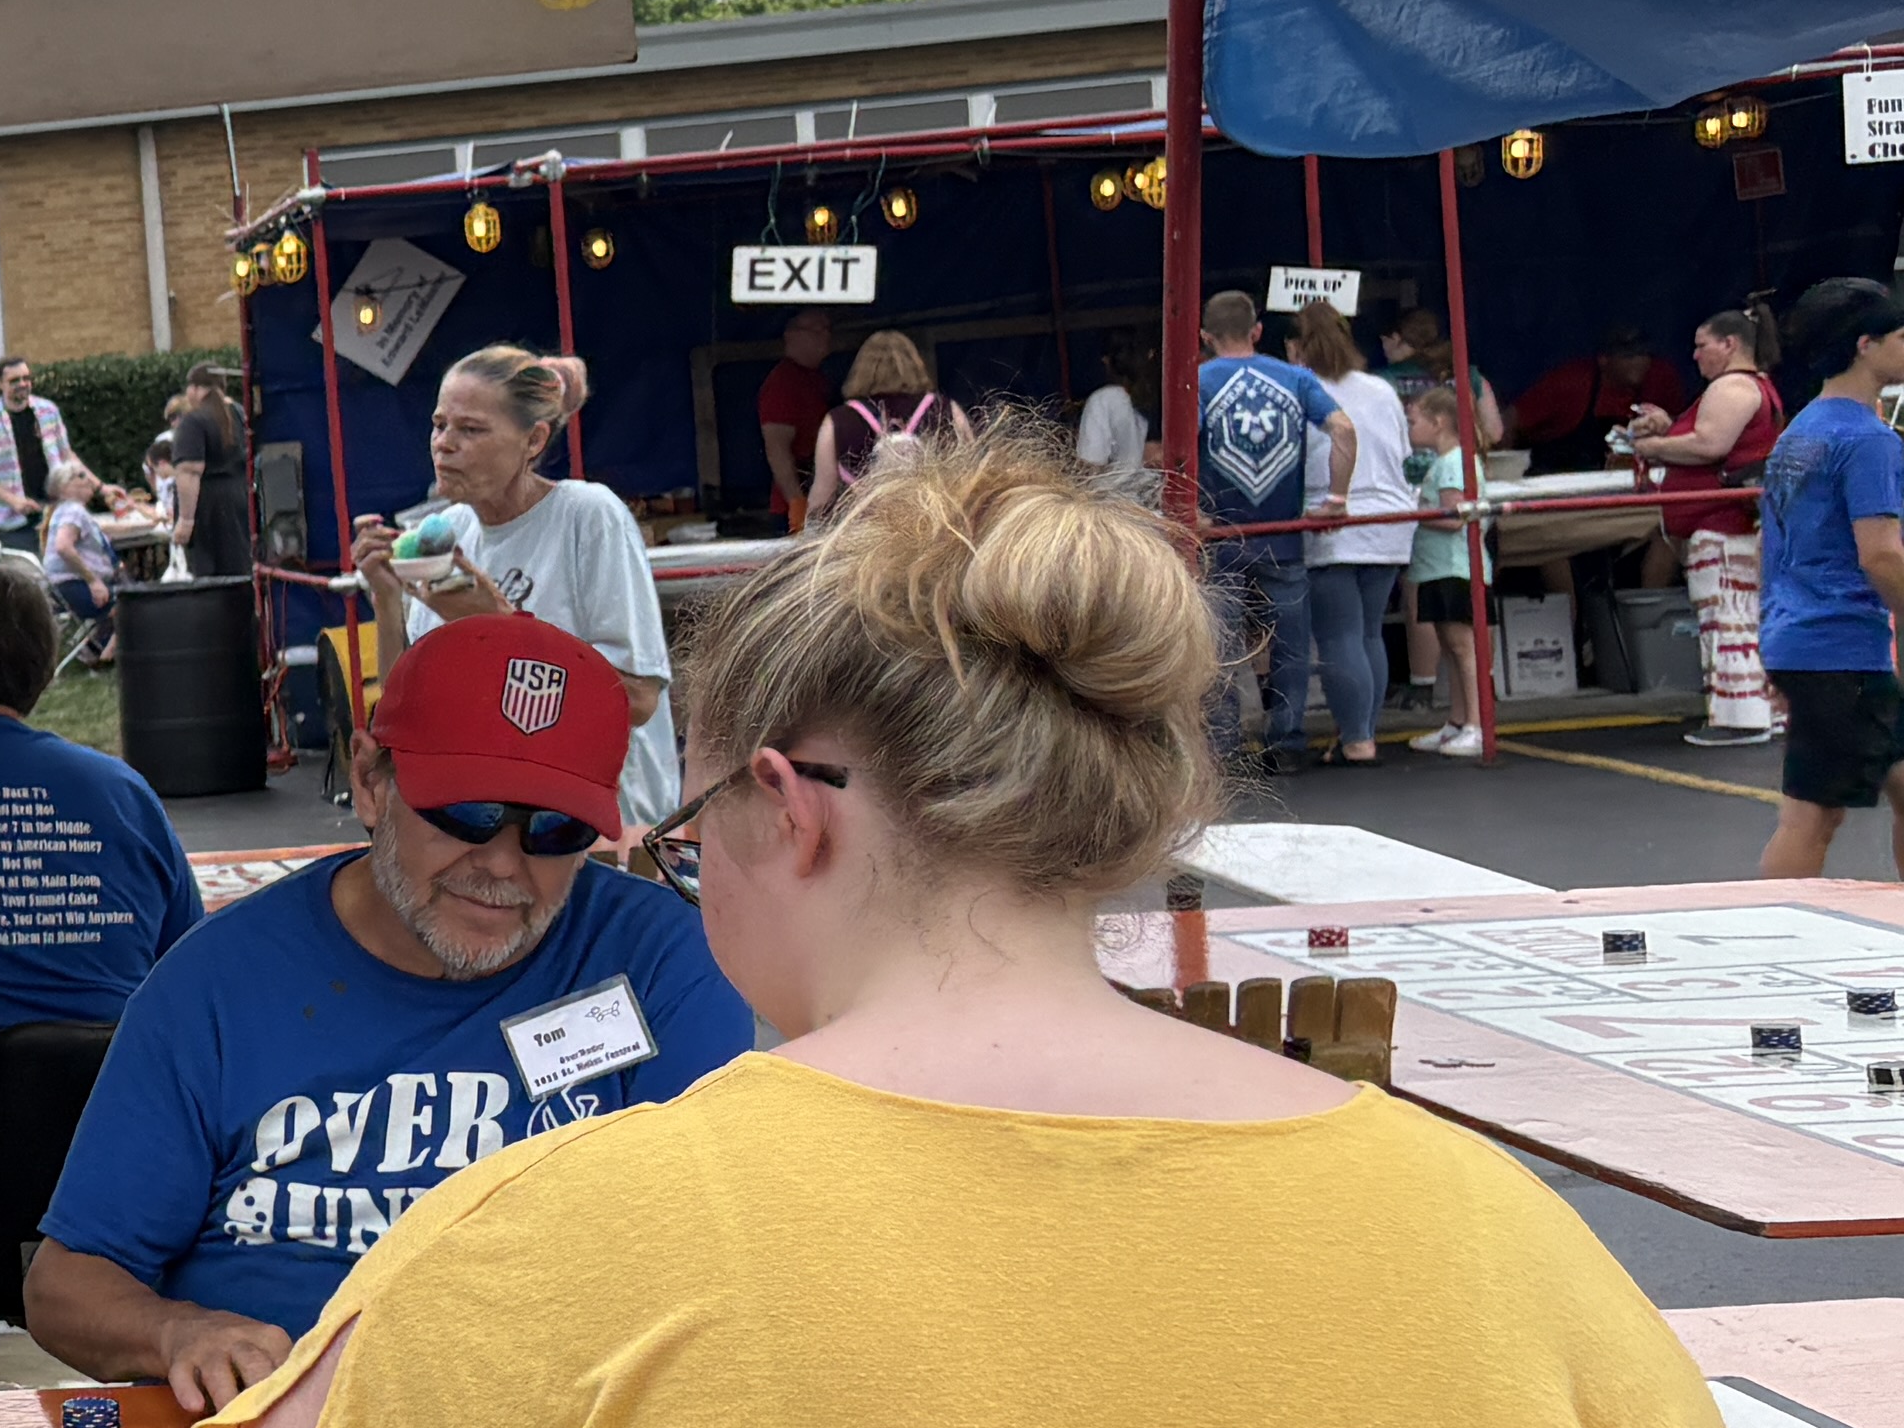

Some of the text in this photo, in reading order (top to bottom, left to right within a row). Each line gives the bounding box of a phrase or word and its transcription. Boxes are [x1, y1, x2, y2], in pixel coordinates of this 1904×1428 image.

[747, 255, 862, 294] EXIT
[1284, 276, 1342, 293] PICK UP
[510, 660, 563, 692] USA
[533, 1027, 567, 1048] Tom
[250, 1071, 510, 1174] OVER
